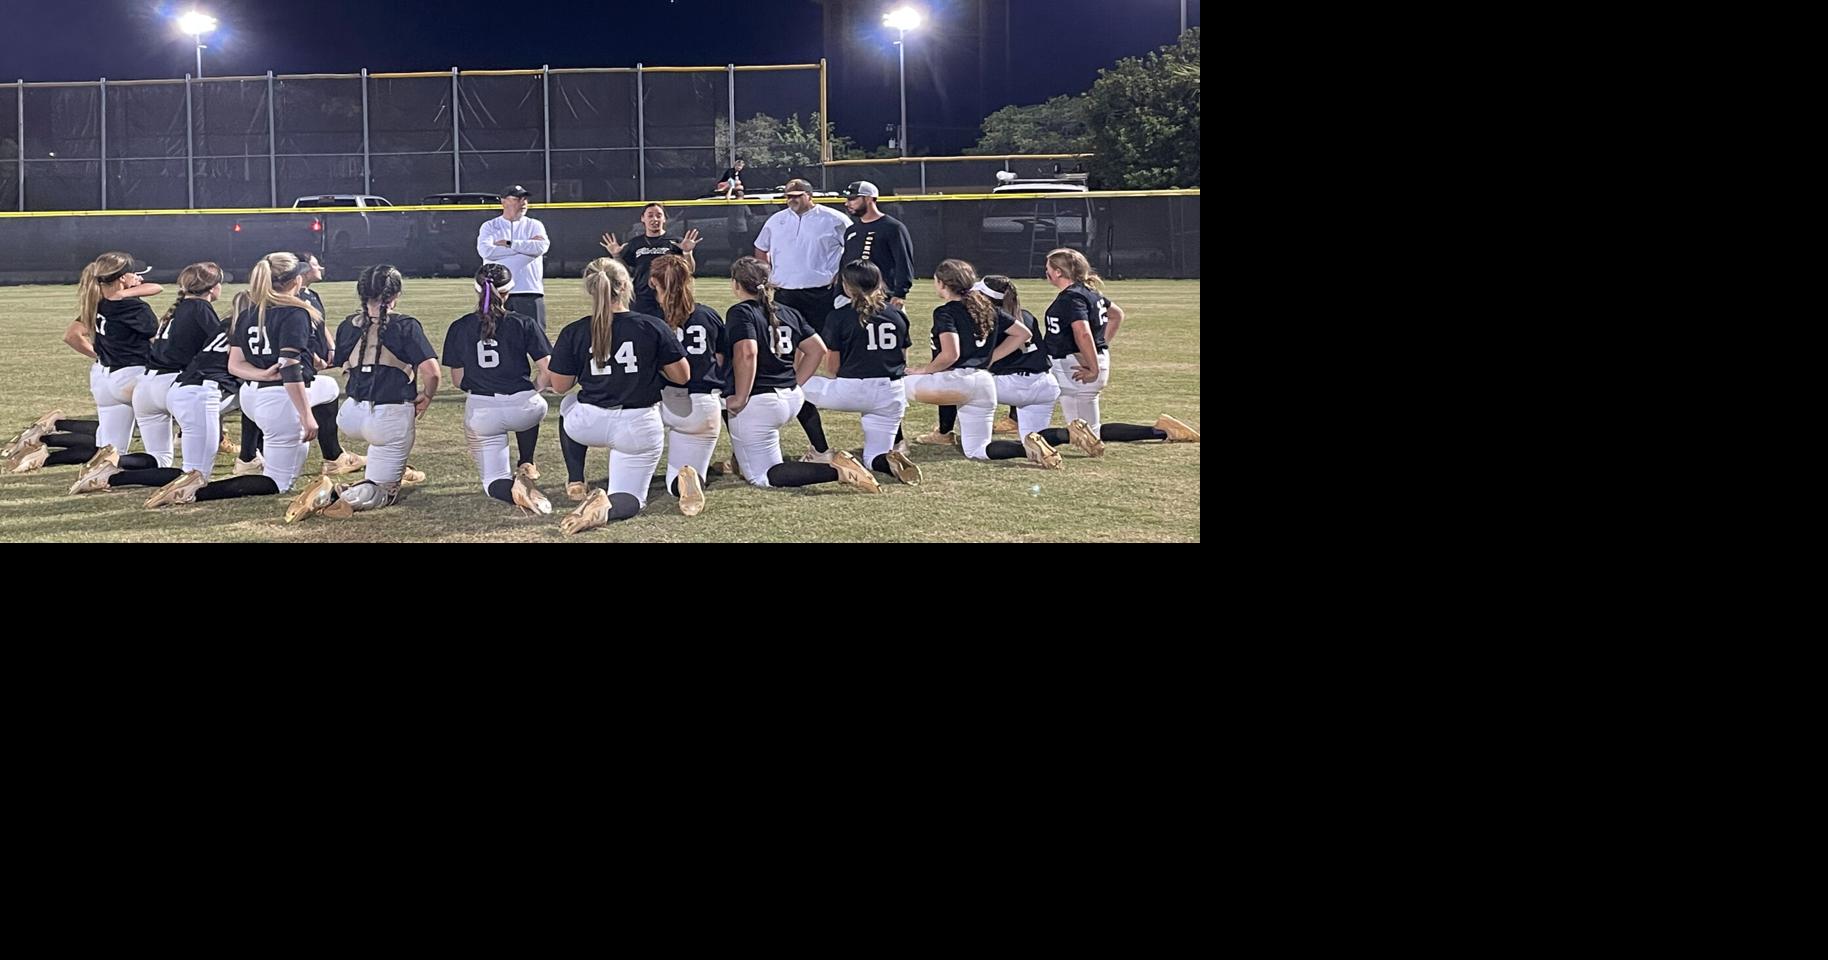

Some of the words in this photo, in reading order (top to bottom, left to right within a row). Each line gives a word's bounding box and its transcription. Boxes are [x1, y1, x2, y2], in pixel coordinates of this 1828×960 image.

[247, 326, 272, 355] 21
[866, 322, 898, 350] 16
[477, 338, 499, 368] 6
